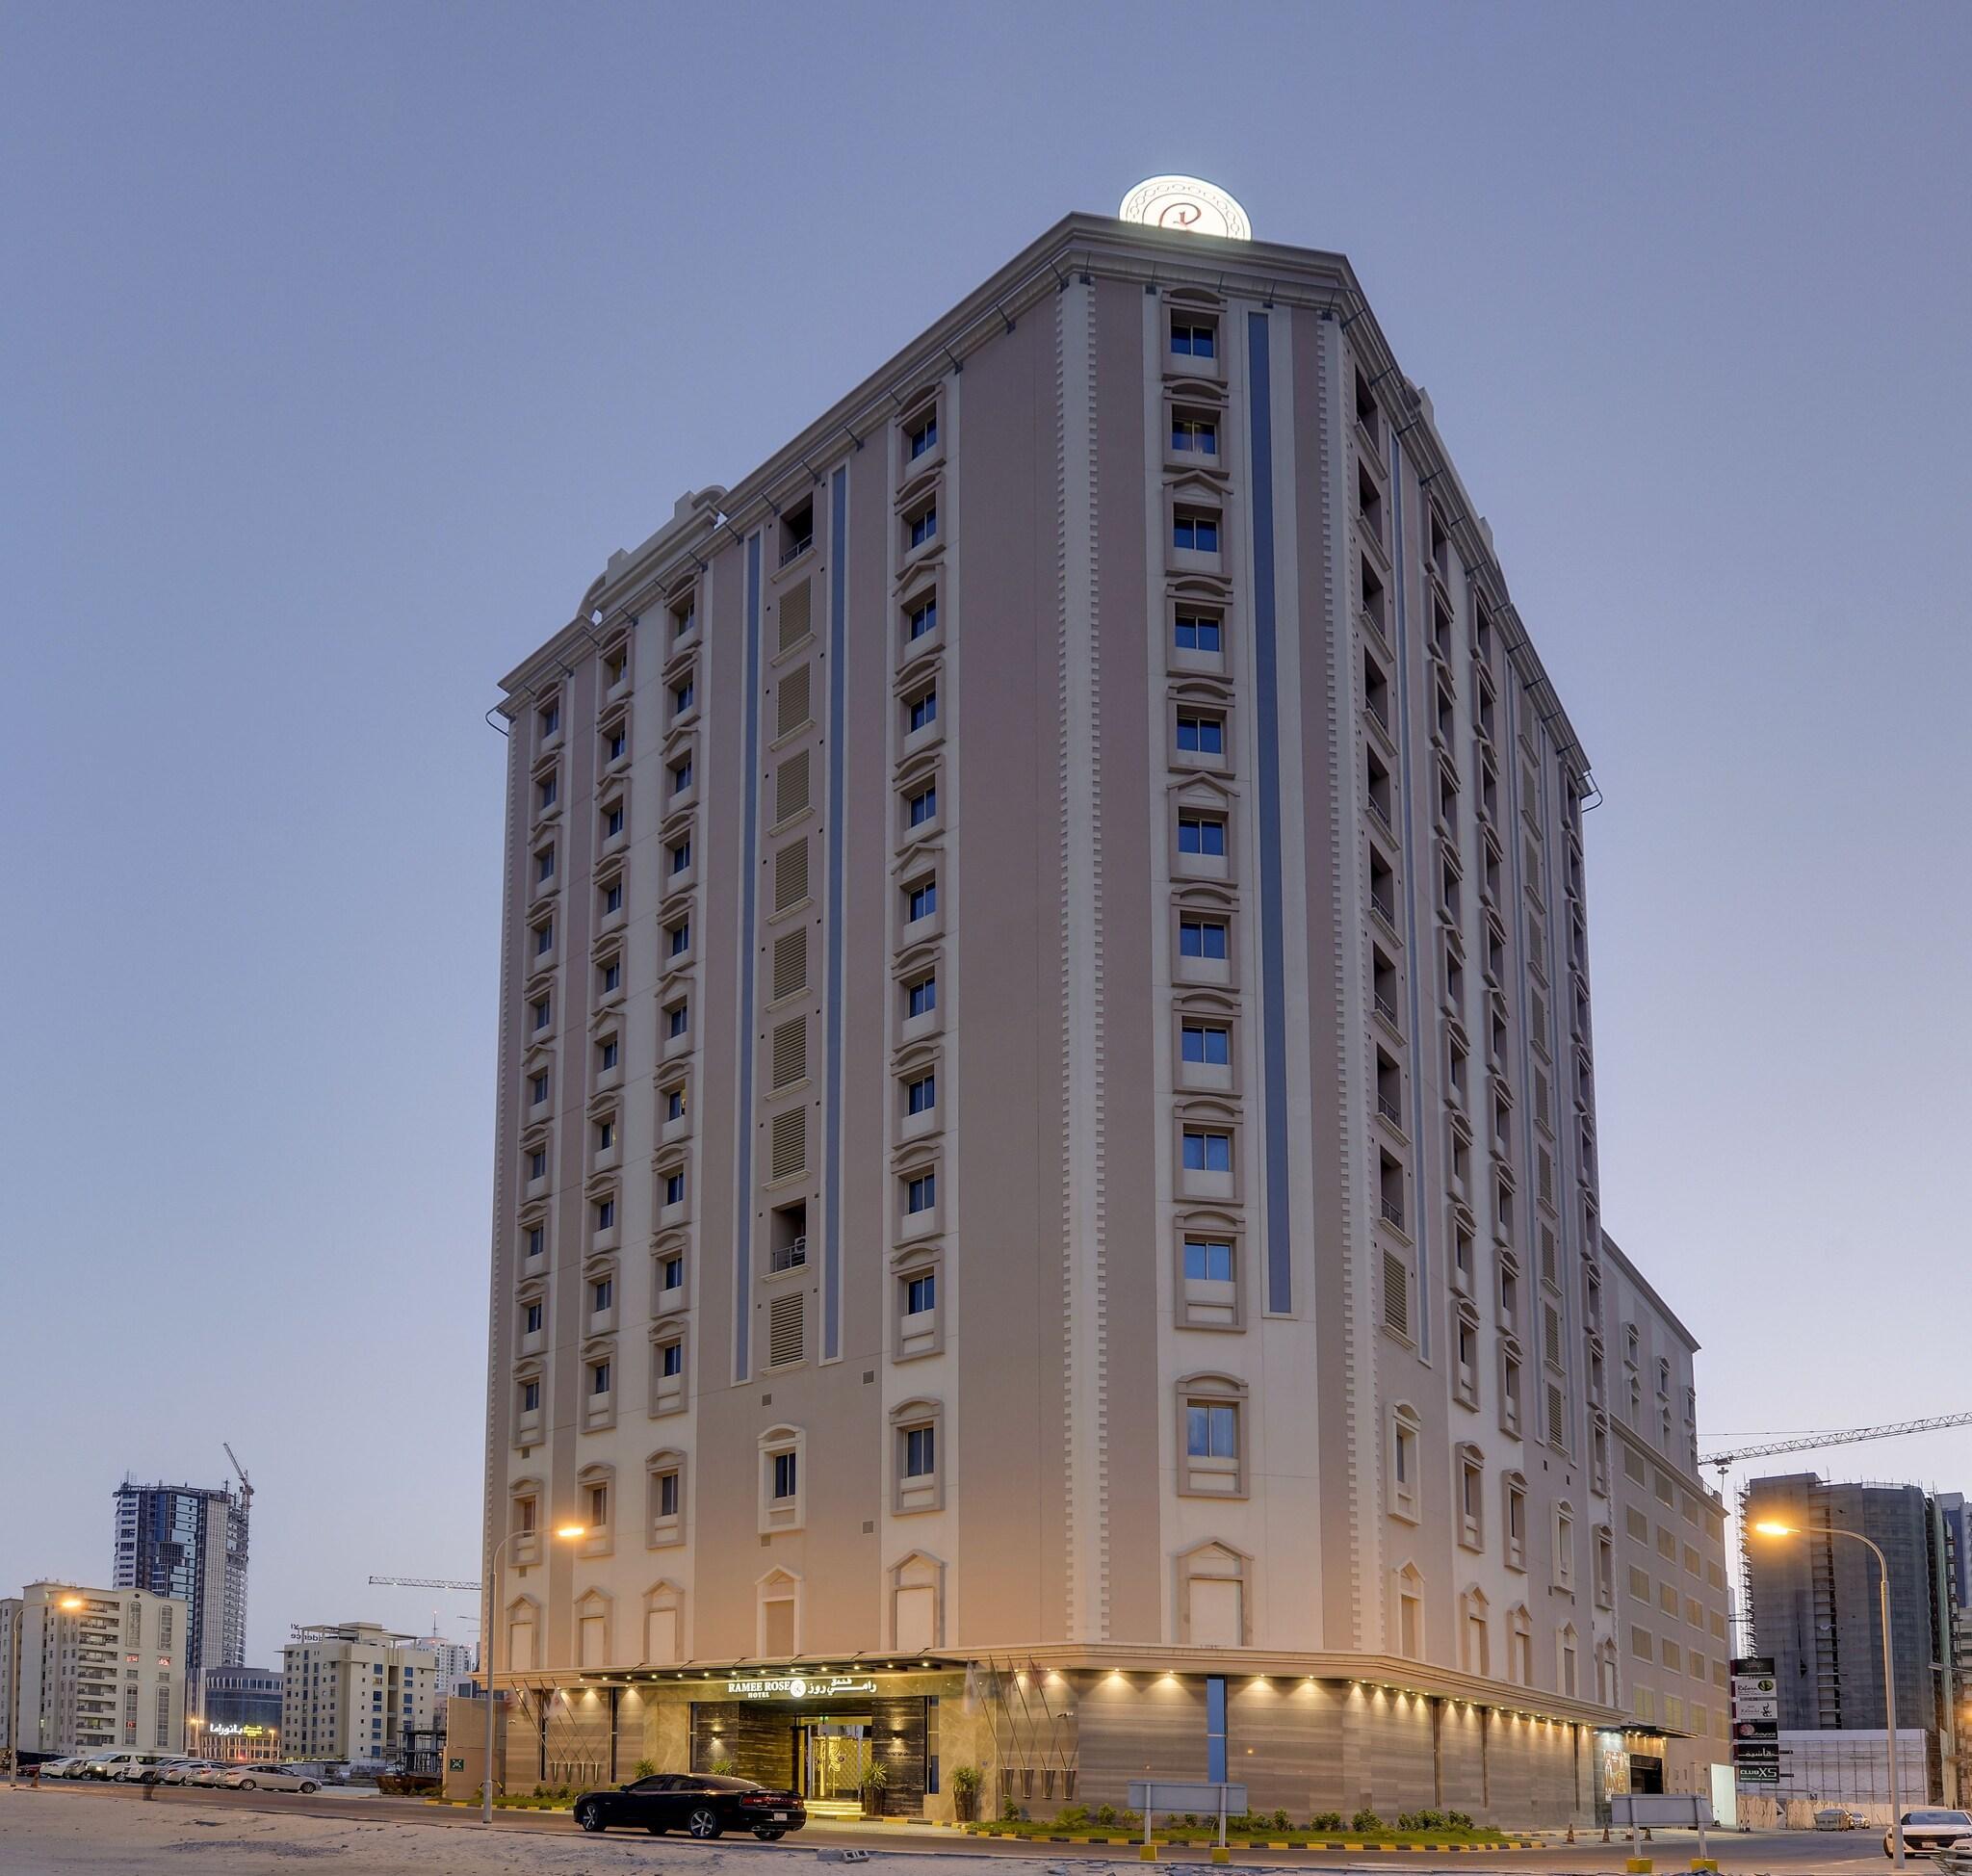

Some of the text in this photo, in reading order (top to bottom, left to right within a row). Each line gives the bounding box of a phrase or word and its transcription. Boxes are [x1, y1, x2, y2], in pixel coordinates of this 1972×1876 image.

[728, 1681, 791, 1692] RAMEE ROSE
[1758, 1767, 1777, 1778] XS
